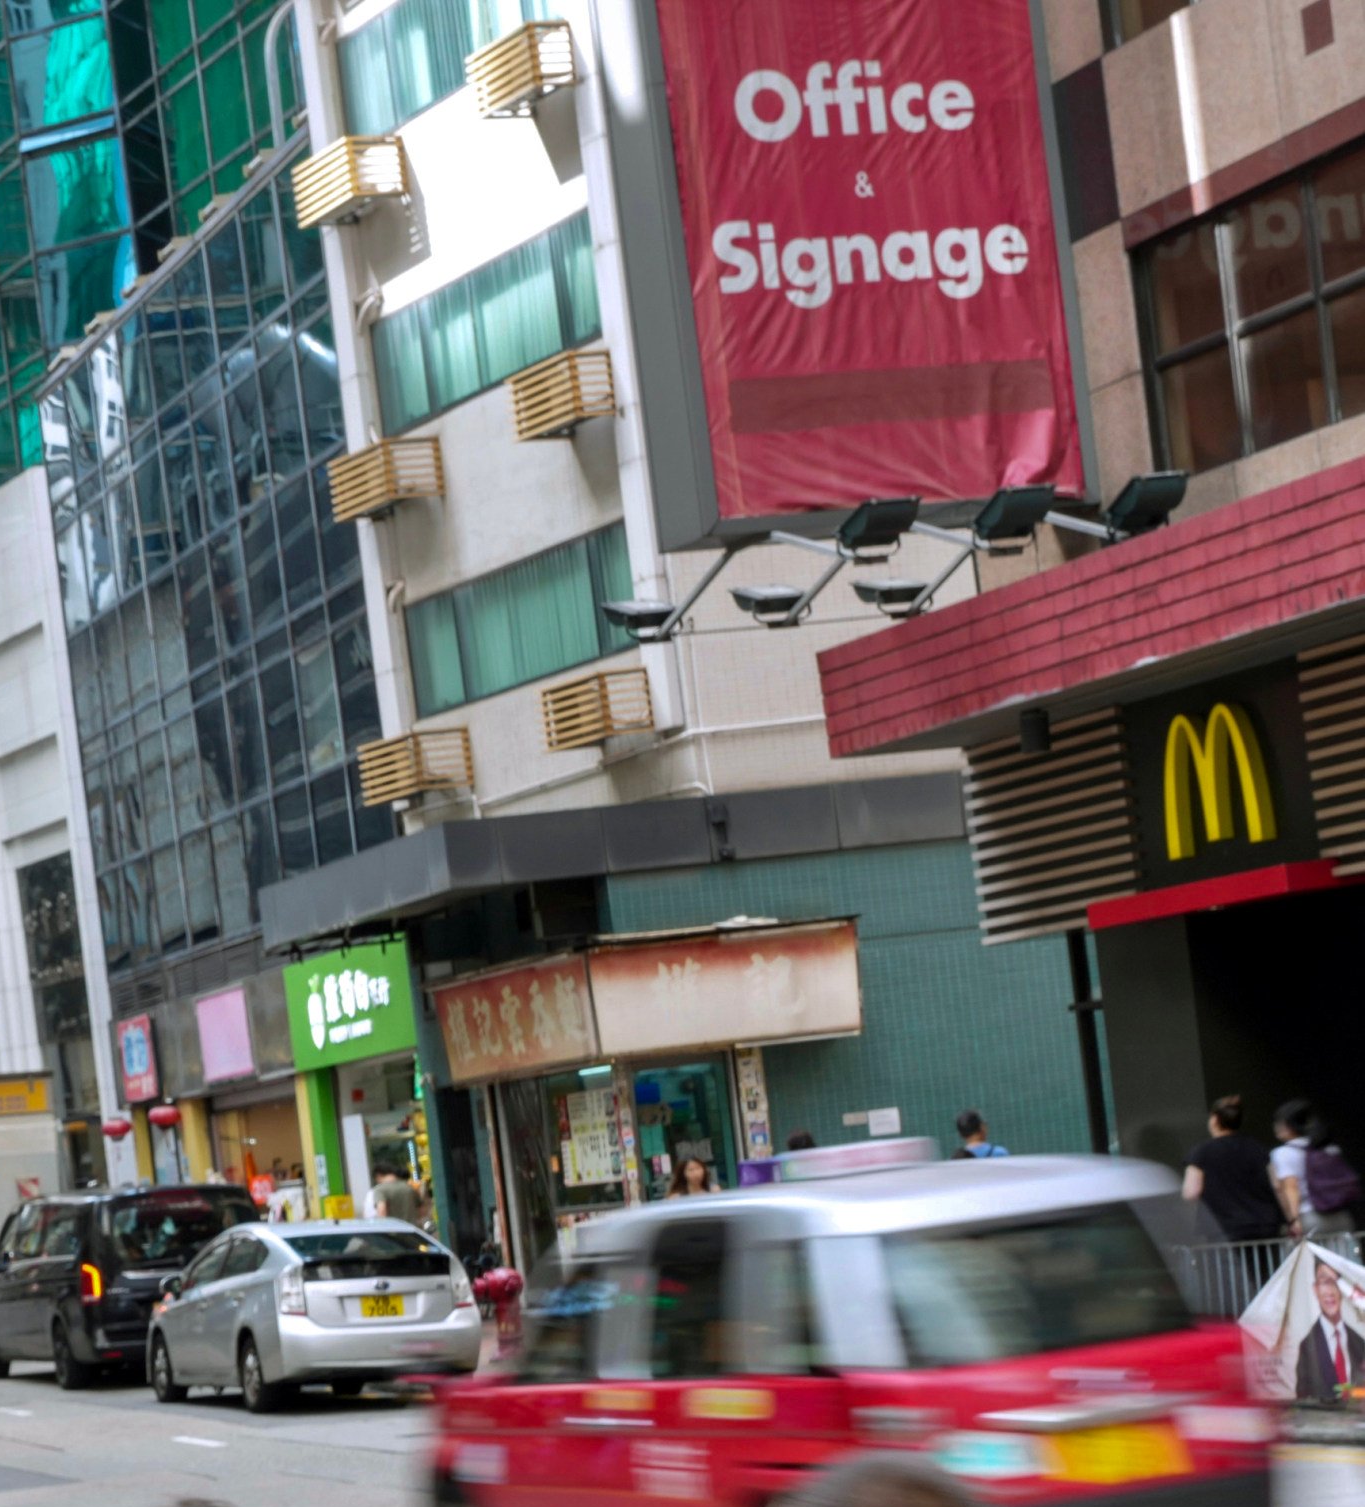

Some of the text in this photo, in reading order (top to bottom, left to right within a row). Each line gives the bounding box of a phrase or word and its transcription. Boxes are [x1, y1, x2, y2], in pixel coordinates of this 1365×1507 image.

[734, 59, 976, 143] Office
[854, 171, 875, 199] &
[711, 220, 1030, 309] Signage
